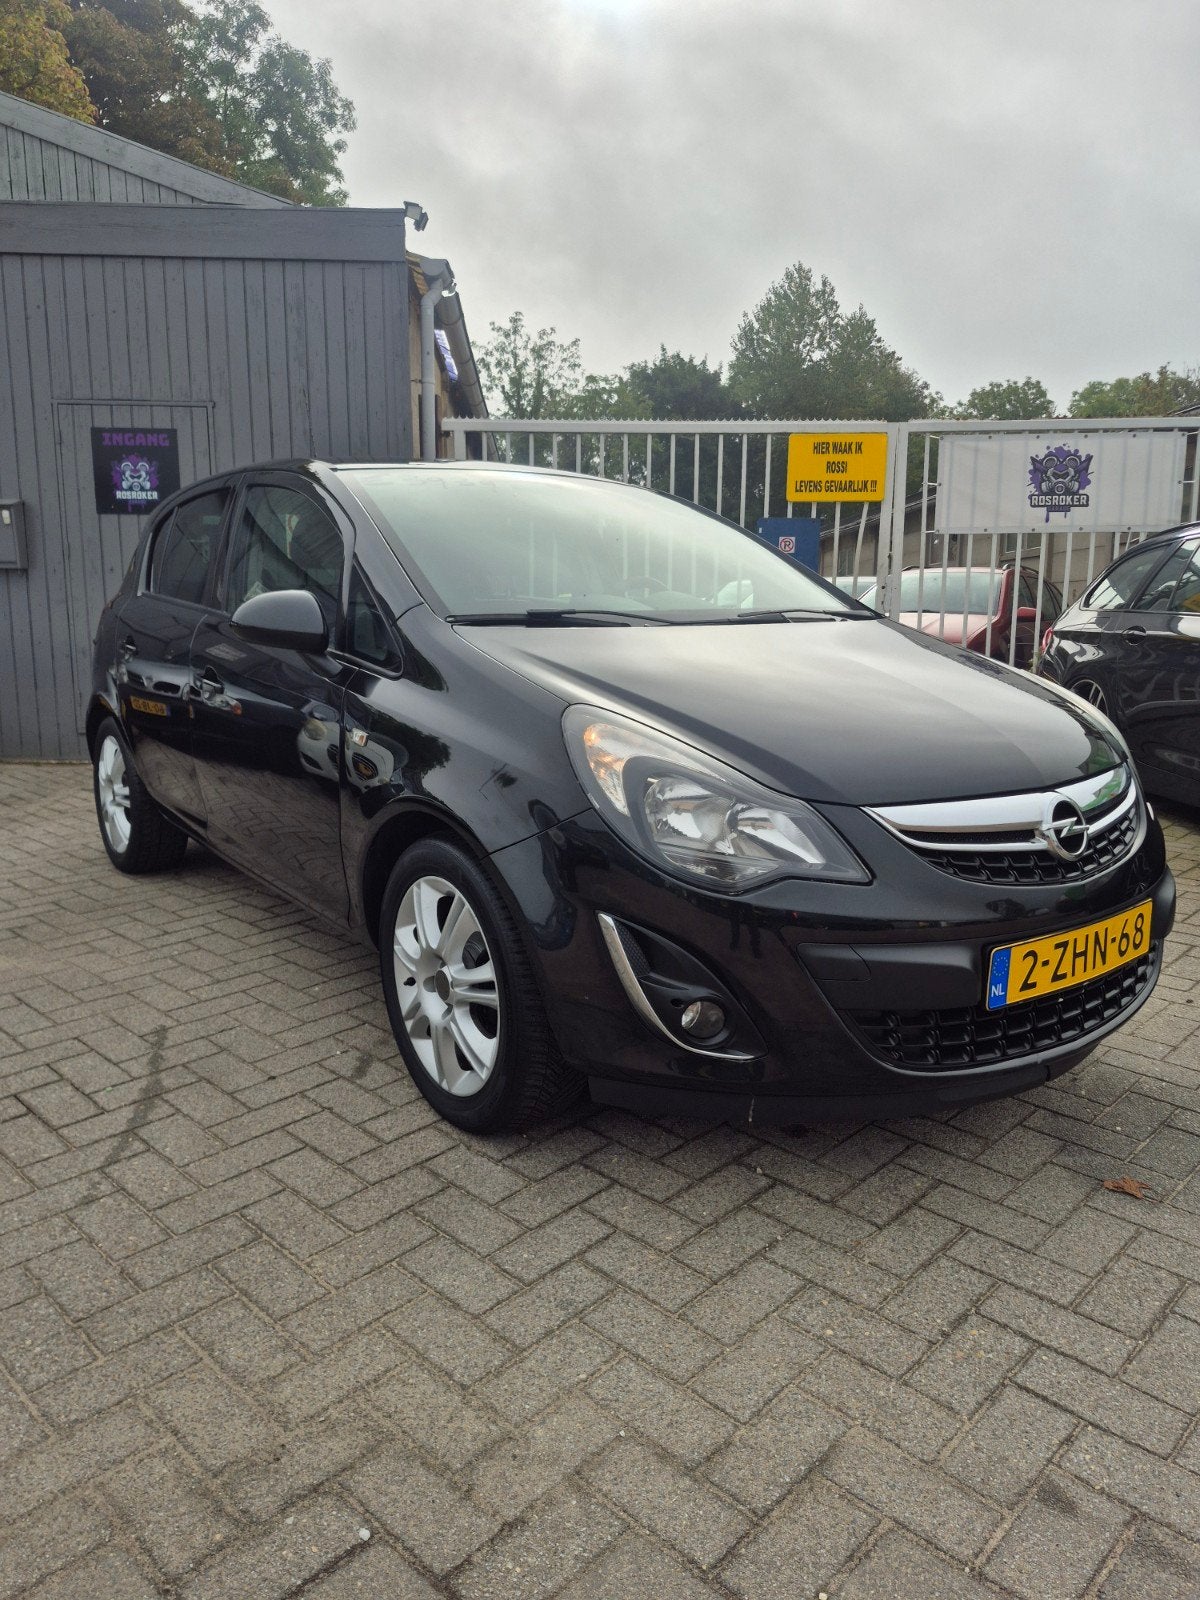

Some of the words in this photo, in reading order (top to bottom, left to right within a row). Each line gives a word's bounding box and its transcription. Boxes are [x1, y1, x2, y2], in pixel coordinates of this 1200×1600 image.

[102, 433, 169, 446] INGANG
[813, 442, 830, 454] HIER
[832, 442, 853, 454] WAAK
[855, 442, 863, 454] IK
[826, 461, 847, 473] ROSSI
[795, 481, 822, 492] LEVENS
[825, 480, 868, 492] GEVAARLIJK
[116, 491, 158, 499] ROSROKER
[1031, 495, 1087, 505] ROSROKER
[1019, 913, 1144, 992] 2-ZHN-68
[991, 983, 1005, 997] NL
